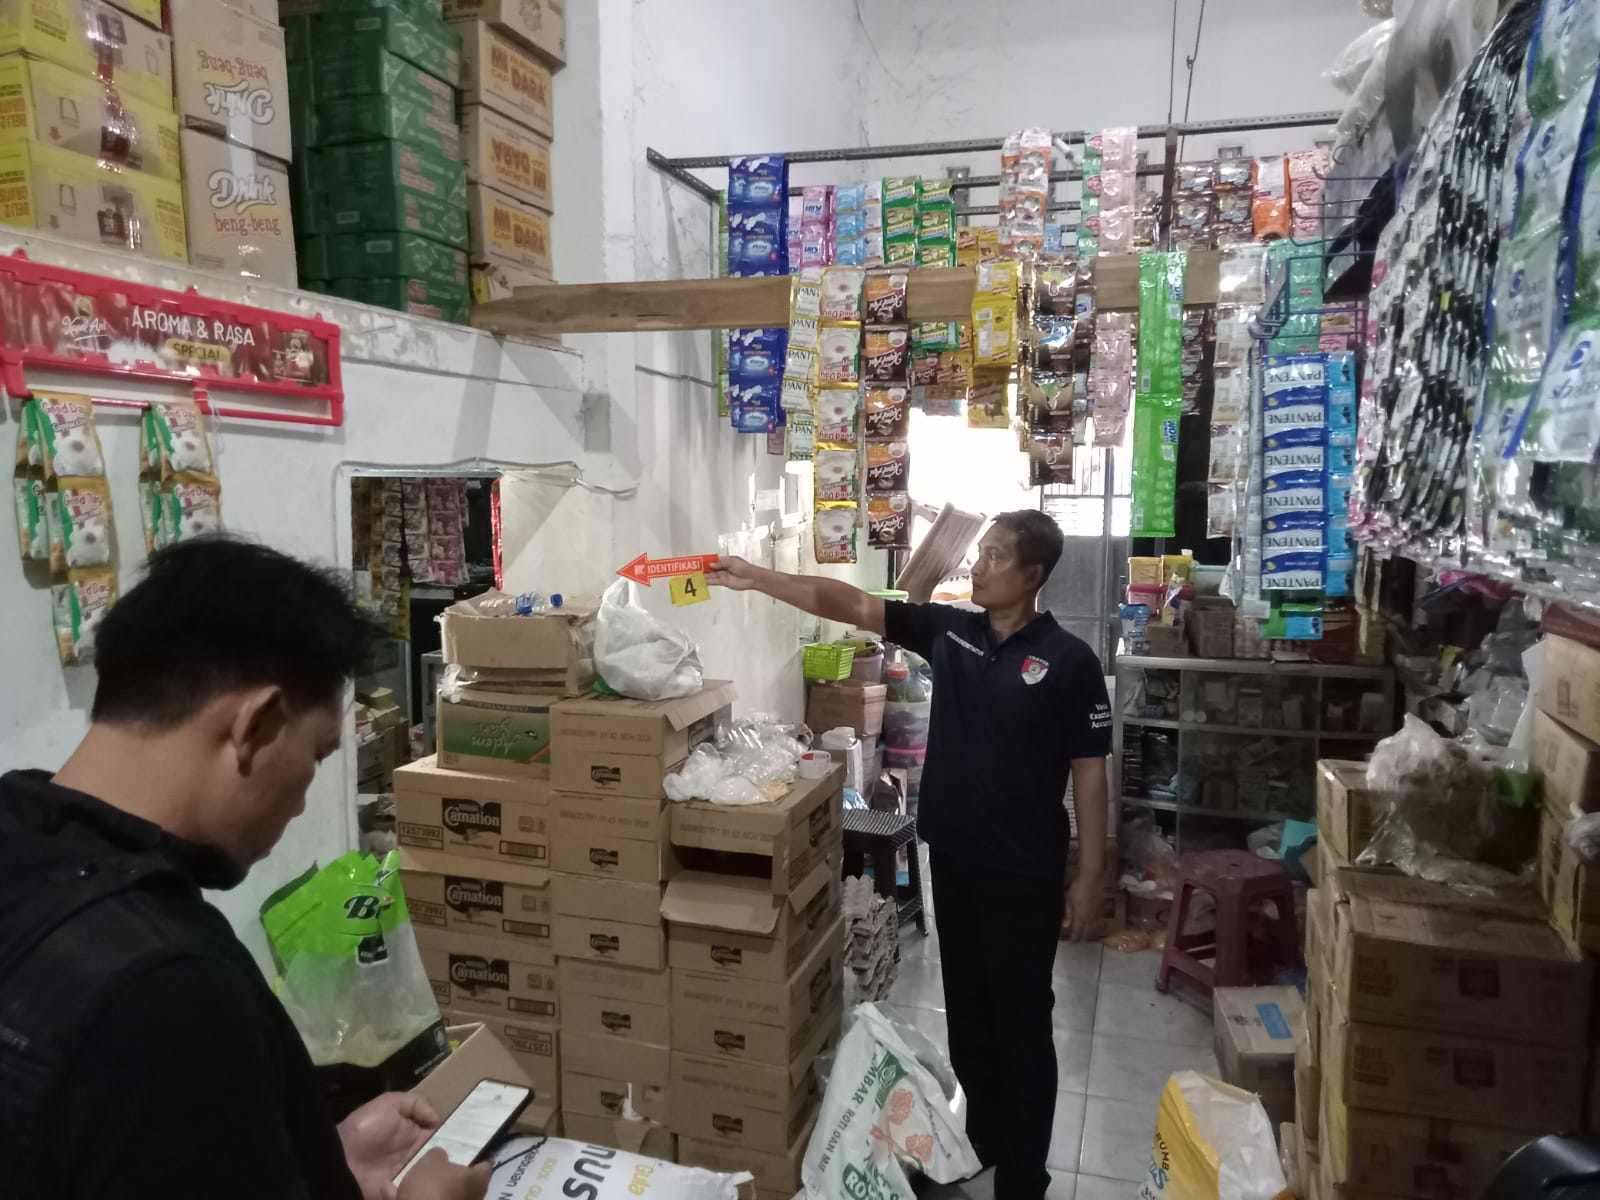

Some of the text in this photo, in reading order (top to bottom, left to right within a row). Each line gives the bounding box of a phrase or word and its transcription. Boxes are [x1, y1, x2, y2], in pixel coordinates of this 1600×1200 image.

[207, 170, 276, 214] Drink
[214, 212, 280, 236] beng-beng
[132, 307, 256, 347] AROMA & RASA
[171, 342, 225, 362] SPECIAL
[1268, 412, 1322, 424] PANTENE
[1267, 454, 1321, 466] PANTENE
[1266, 496, 1321, 507] PANTENE
[1266, 537, 1320, 548] PANTENE
[648, 560, 700, 574] IDENTIFIKASI
[684, 578, 697, 597] 4
[1265, 578, 1320, 588] PANTENE
[445, 806, 500, 827] Carnation
[446, 884, 502, 906] Carnation
[451, 962, 509, 985] Carnation
[838, 1108, 856, 1132] ROTI
